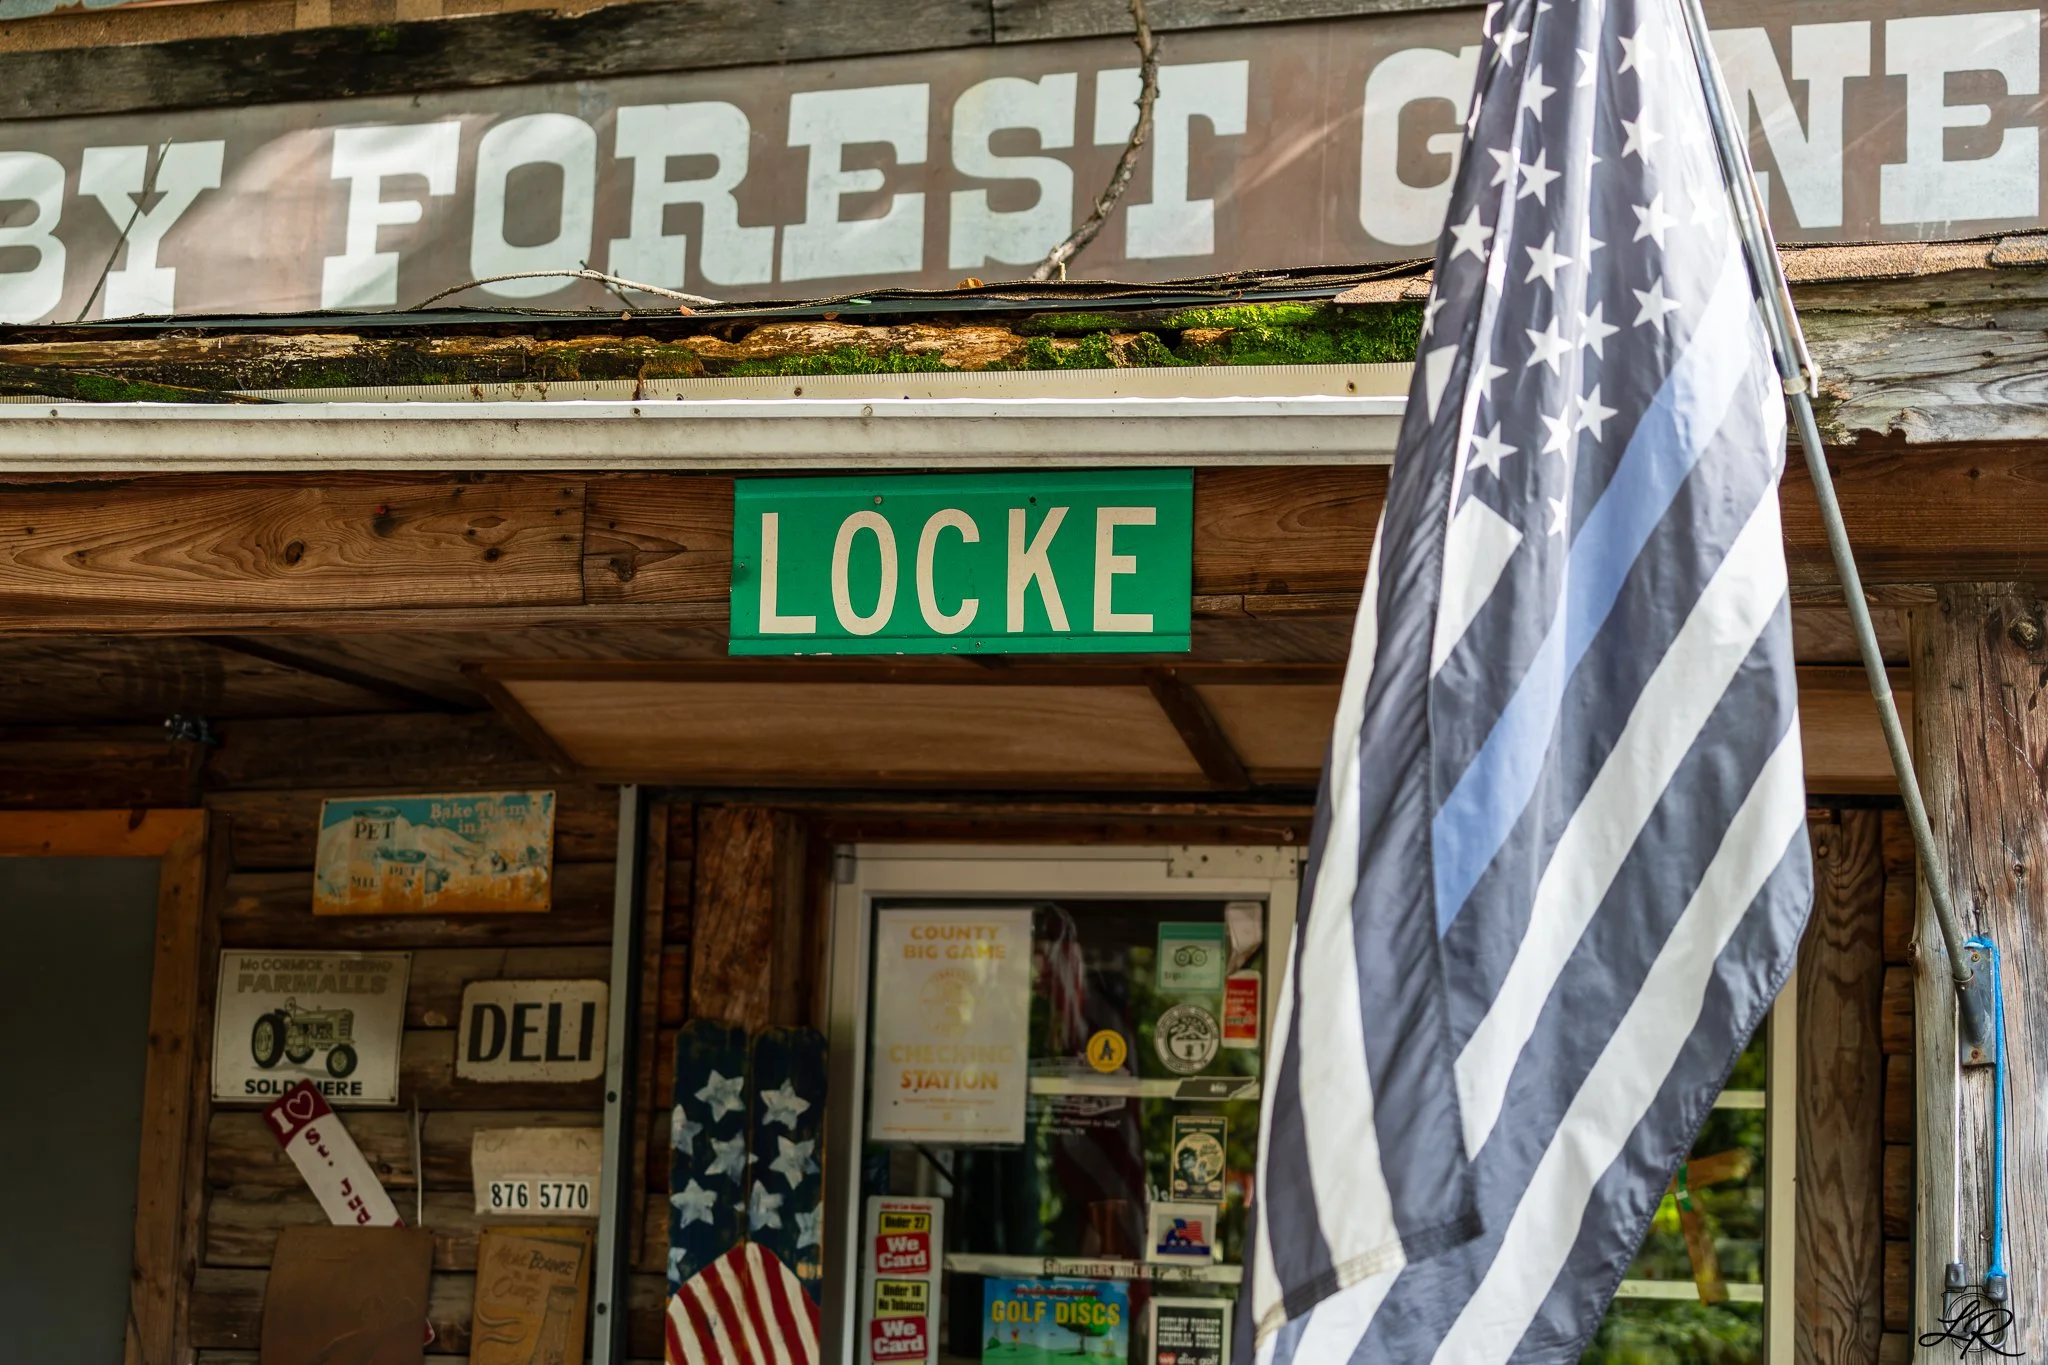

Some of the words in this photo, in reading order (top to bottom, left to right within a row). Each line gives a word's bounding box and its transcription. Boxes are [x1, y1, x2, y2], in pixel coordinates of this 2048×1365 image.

[321, 60, 1250, 310] FOREST
[1359, 8, 2041, 246] GNE
[758, 506, 1157, 636] LOCKE
[354, 821, 395, 841] PET
[910, 925, 1000, 940] COUNTY
[902, 944, 939, 960] BIG
[946, 944, 1007, 960] GAME
[237, 973, 388, 995] FARMALLS
[467, 1002, 596, 1063] DELI
[888, 1044, 1014, 1064] CHECKING
[901, 1069, 999, 1090] STATION
[304, 1128, 334, 1167] St.
[491, 1184, 528, 1208] 876
[540, 1184, 589, 1209] 5770
[885, 1215, 911, 1228] Under
[914, 1216, 925, 1229] 27
[886, 1235, 919, 1253] We
[879, 1250, 927, 1269] Card
[882, 1283, 909, 1297] Under
[878, 1298, 890, 1311] No
[890, 1298, 925, 1313] Tobacco
[991, 1299, 1047, 1323] GOLF
[1055, 1301, 1121, 1326] DISCS
[881, 1319, 917, 1338] We
[873, 1335, 925, 1355] Card
